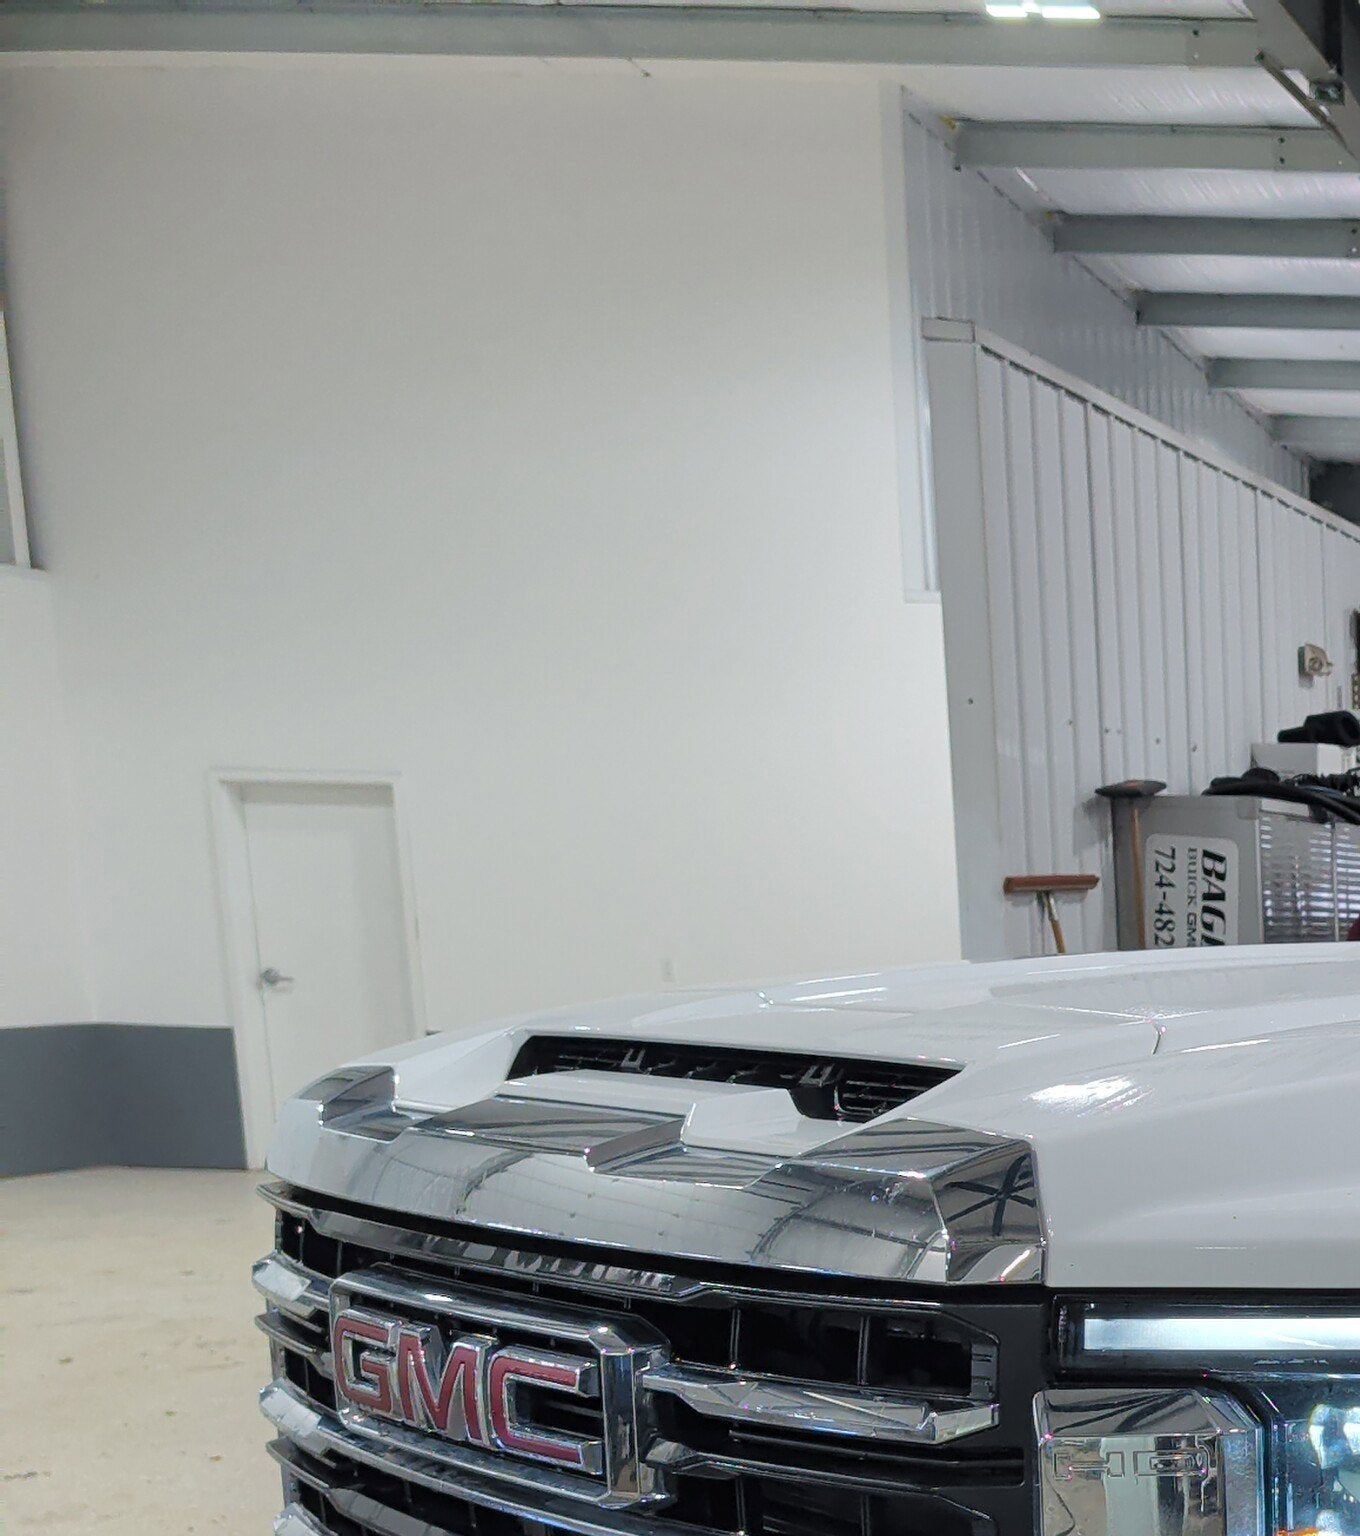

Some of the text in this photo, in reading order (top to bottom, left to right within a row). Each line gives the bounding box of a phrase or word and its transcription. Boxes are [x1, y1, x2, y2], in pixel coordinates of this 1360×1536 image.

[1153, 845, 1177, 947] 724-482
[1187, 847, 1198, 906] BUICK
[334, 1308, 602, 1475] GMC
